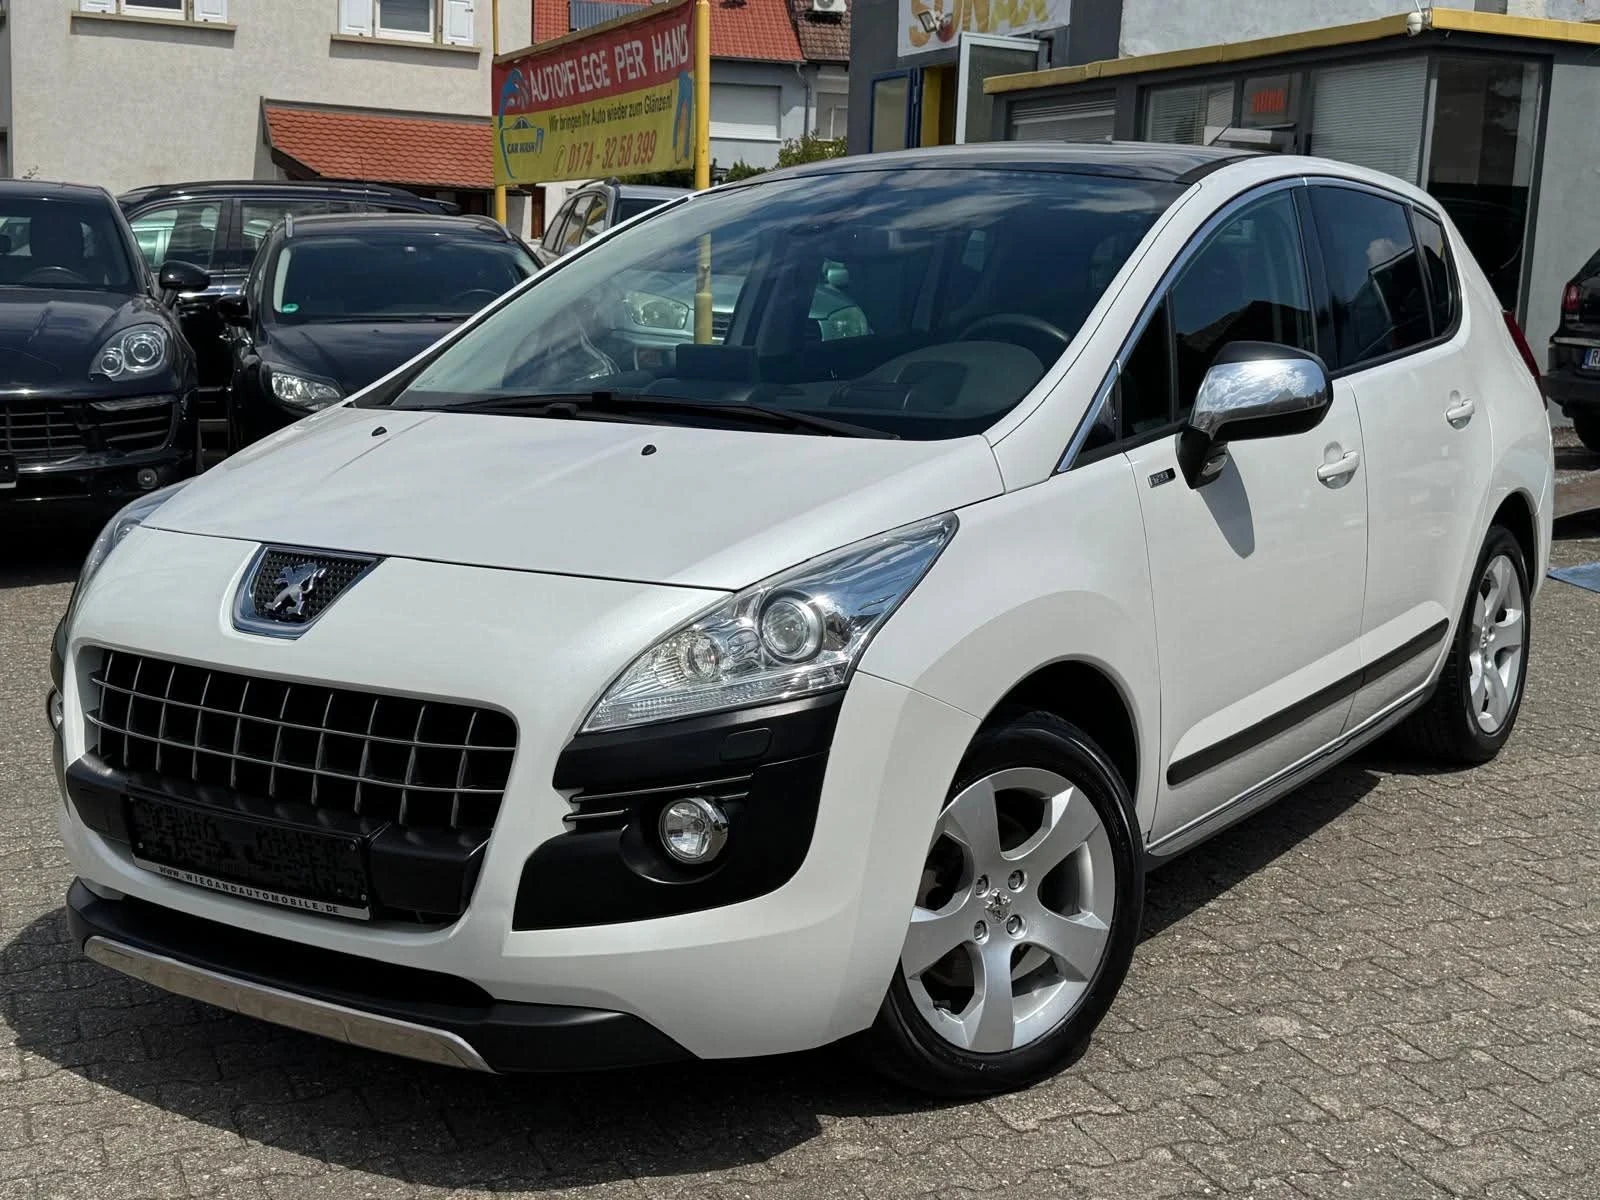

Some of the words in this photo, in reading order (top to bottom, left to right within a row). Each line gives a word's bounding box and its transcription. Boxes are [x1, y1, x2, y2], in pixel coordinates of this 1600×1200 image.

[530, 50, 611, 102] AUTOPFLEGE
[614, 39, 647, 83] PER
[651, 23, 689, 73] HAND
[549, 113, 559, 132] Wir
[560, 113, 582, 133] bringen
[582, 108, 591, 126] Ihr
[592, 107, 606, 124] Auto
[607, 101, 628, 121] wieder
[629, 102, 643, 118] zum
[644, 89, 672, 114] Glänzen!
[567, 142, 594, 174] 0174
[602, 136, 617, 169] 32
[618, 133, 633, 167] 58
[634, 129, 657, 165] 399
